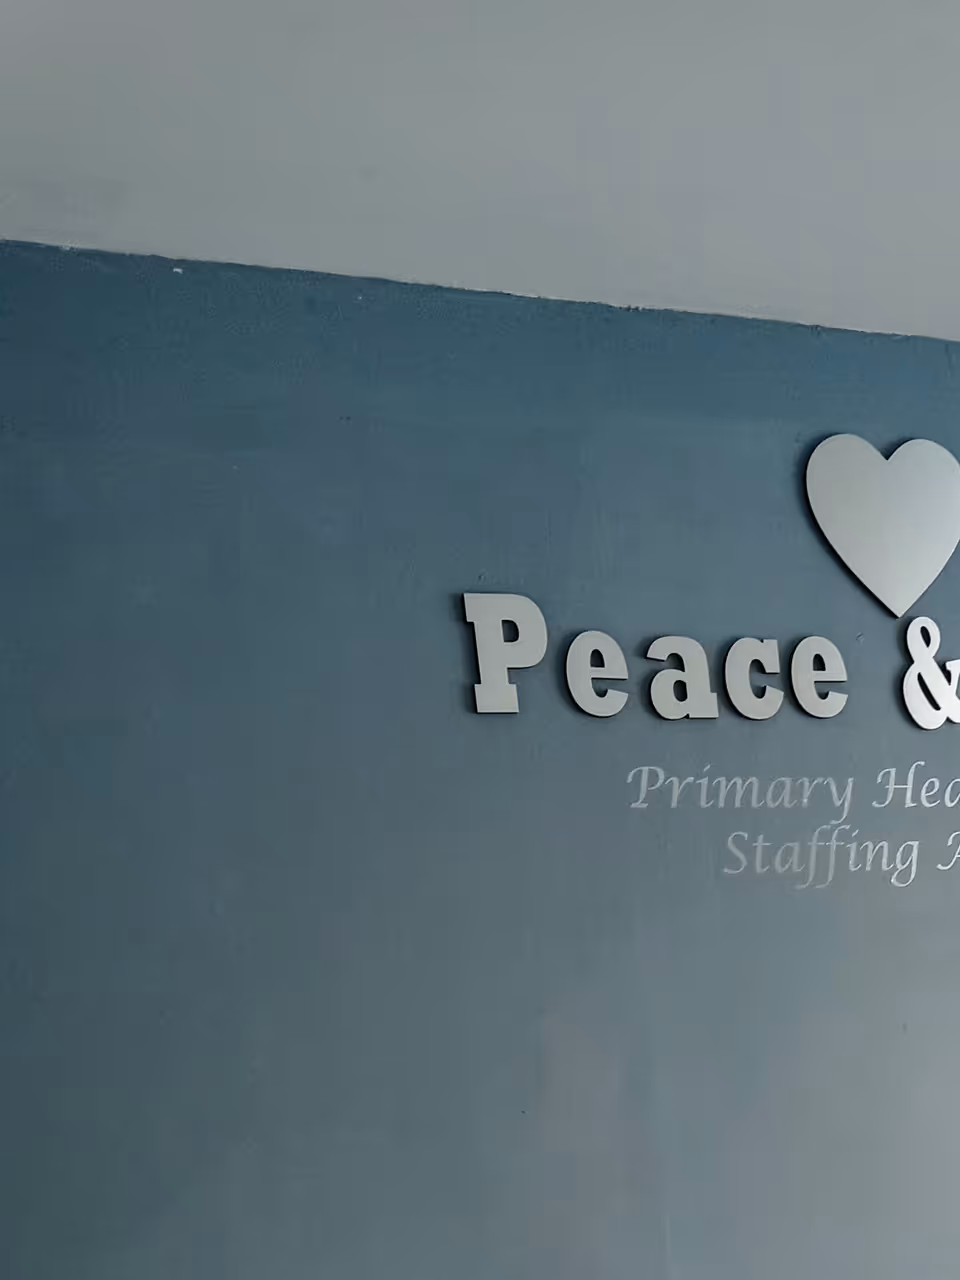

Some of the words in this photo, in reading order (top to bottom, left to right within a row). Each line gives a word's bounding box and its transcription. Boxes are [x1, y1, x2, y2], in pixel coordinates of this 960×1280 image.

[464, 592, 849, 721] Peace
[626, 763, 855, 825] Primary
[722, 823, 920, 889] Staffing
